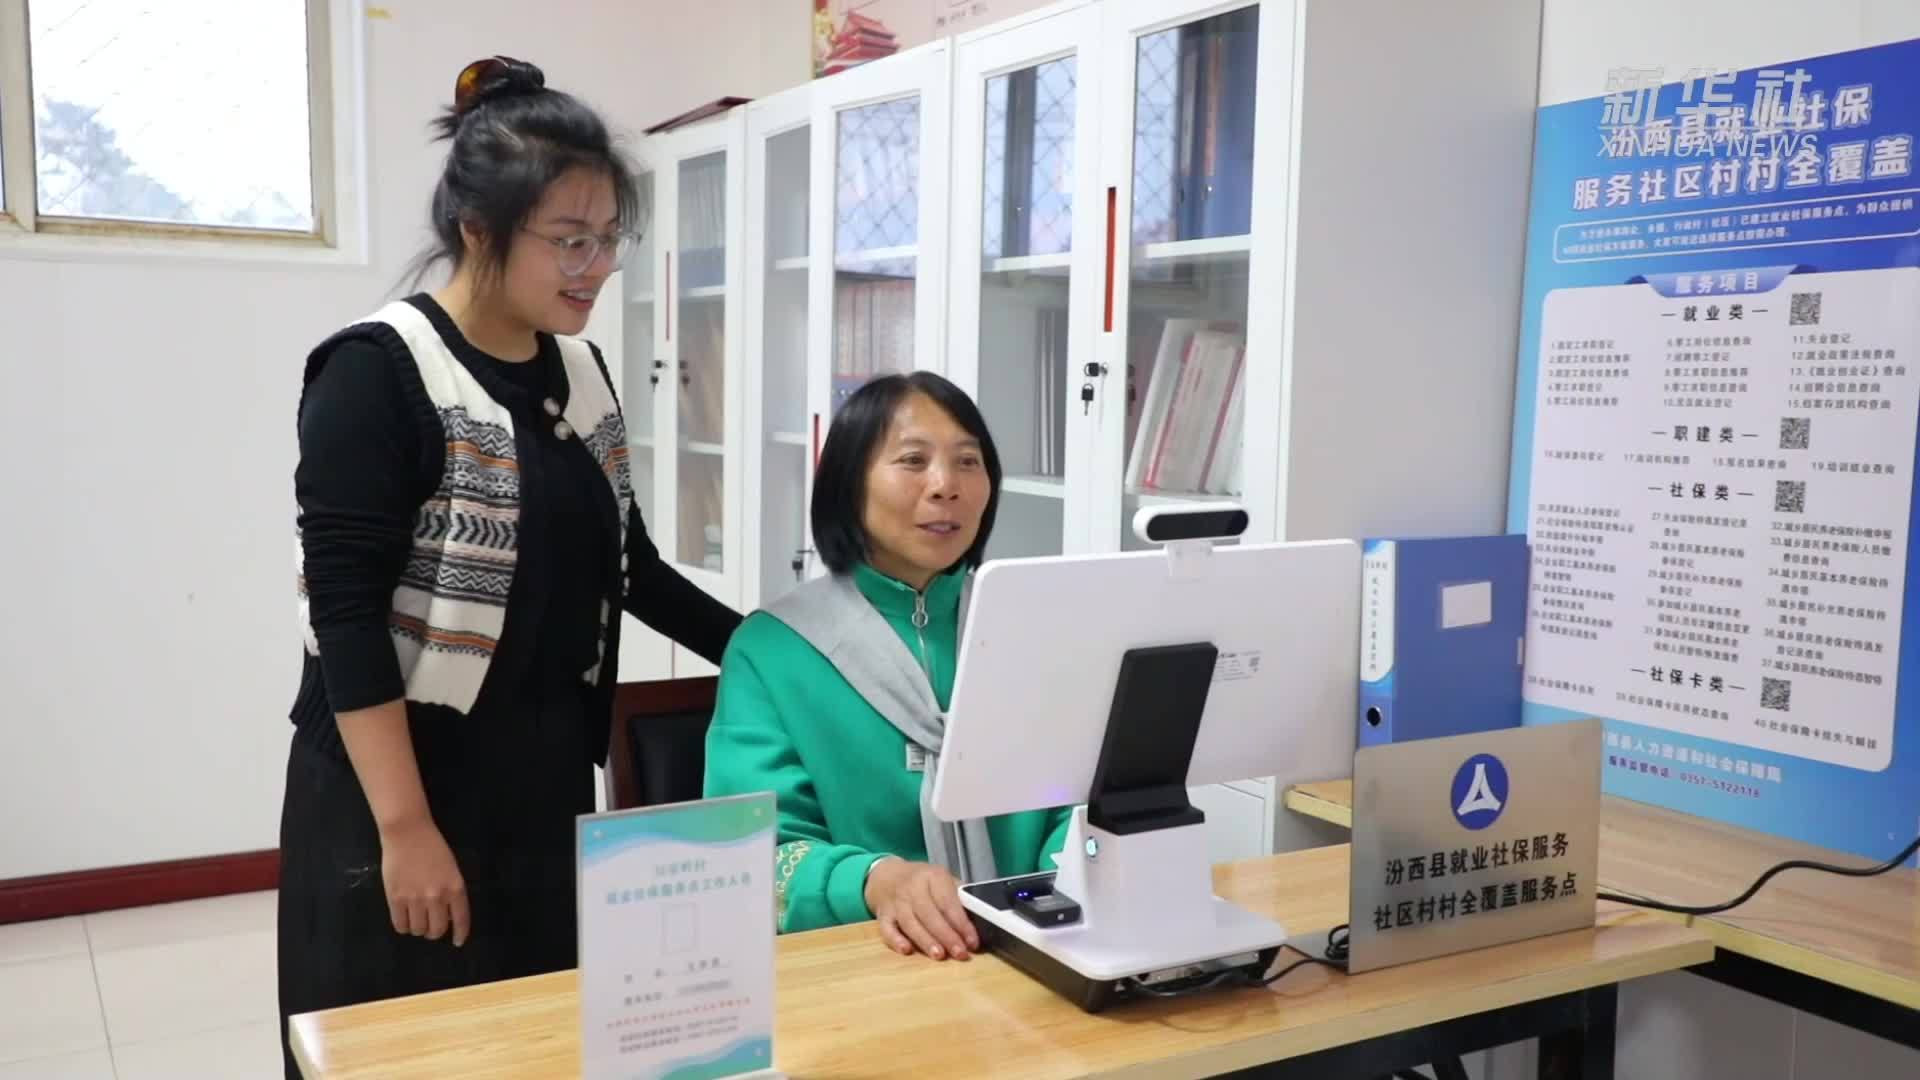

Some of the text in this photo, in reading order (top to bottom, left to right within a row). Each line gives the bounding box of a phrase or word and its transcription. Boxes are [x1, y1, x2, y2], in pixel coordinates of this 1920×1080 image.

[1609, 85, 1872, 158] 汾西县就业社保
[1572, 134, 1913, 210] 服务社区村村全覆盖
[1675, 271, 1759, 294] 服务项目
[1793, 333, 1852, 345] 11.失业登记
[1789, 382, 1881, 393] 14.招聘会信息查询
[1673, 425, 1734, 443] 职建类
[1669, 482, 1729, 501] 社保类
[1650, 664, 1725, 693] 社保卡类
[1602, 730, 1782, 784] 西县人力资源和社会保障局
[1384, 831, 1570, 887] 汾西县就业社保服务
[1374, 871, 1578, 932] 社区村村全覆盖服务点
